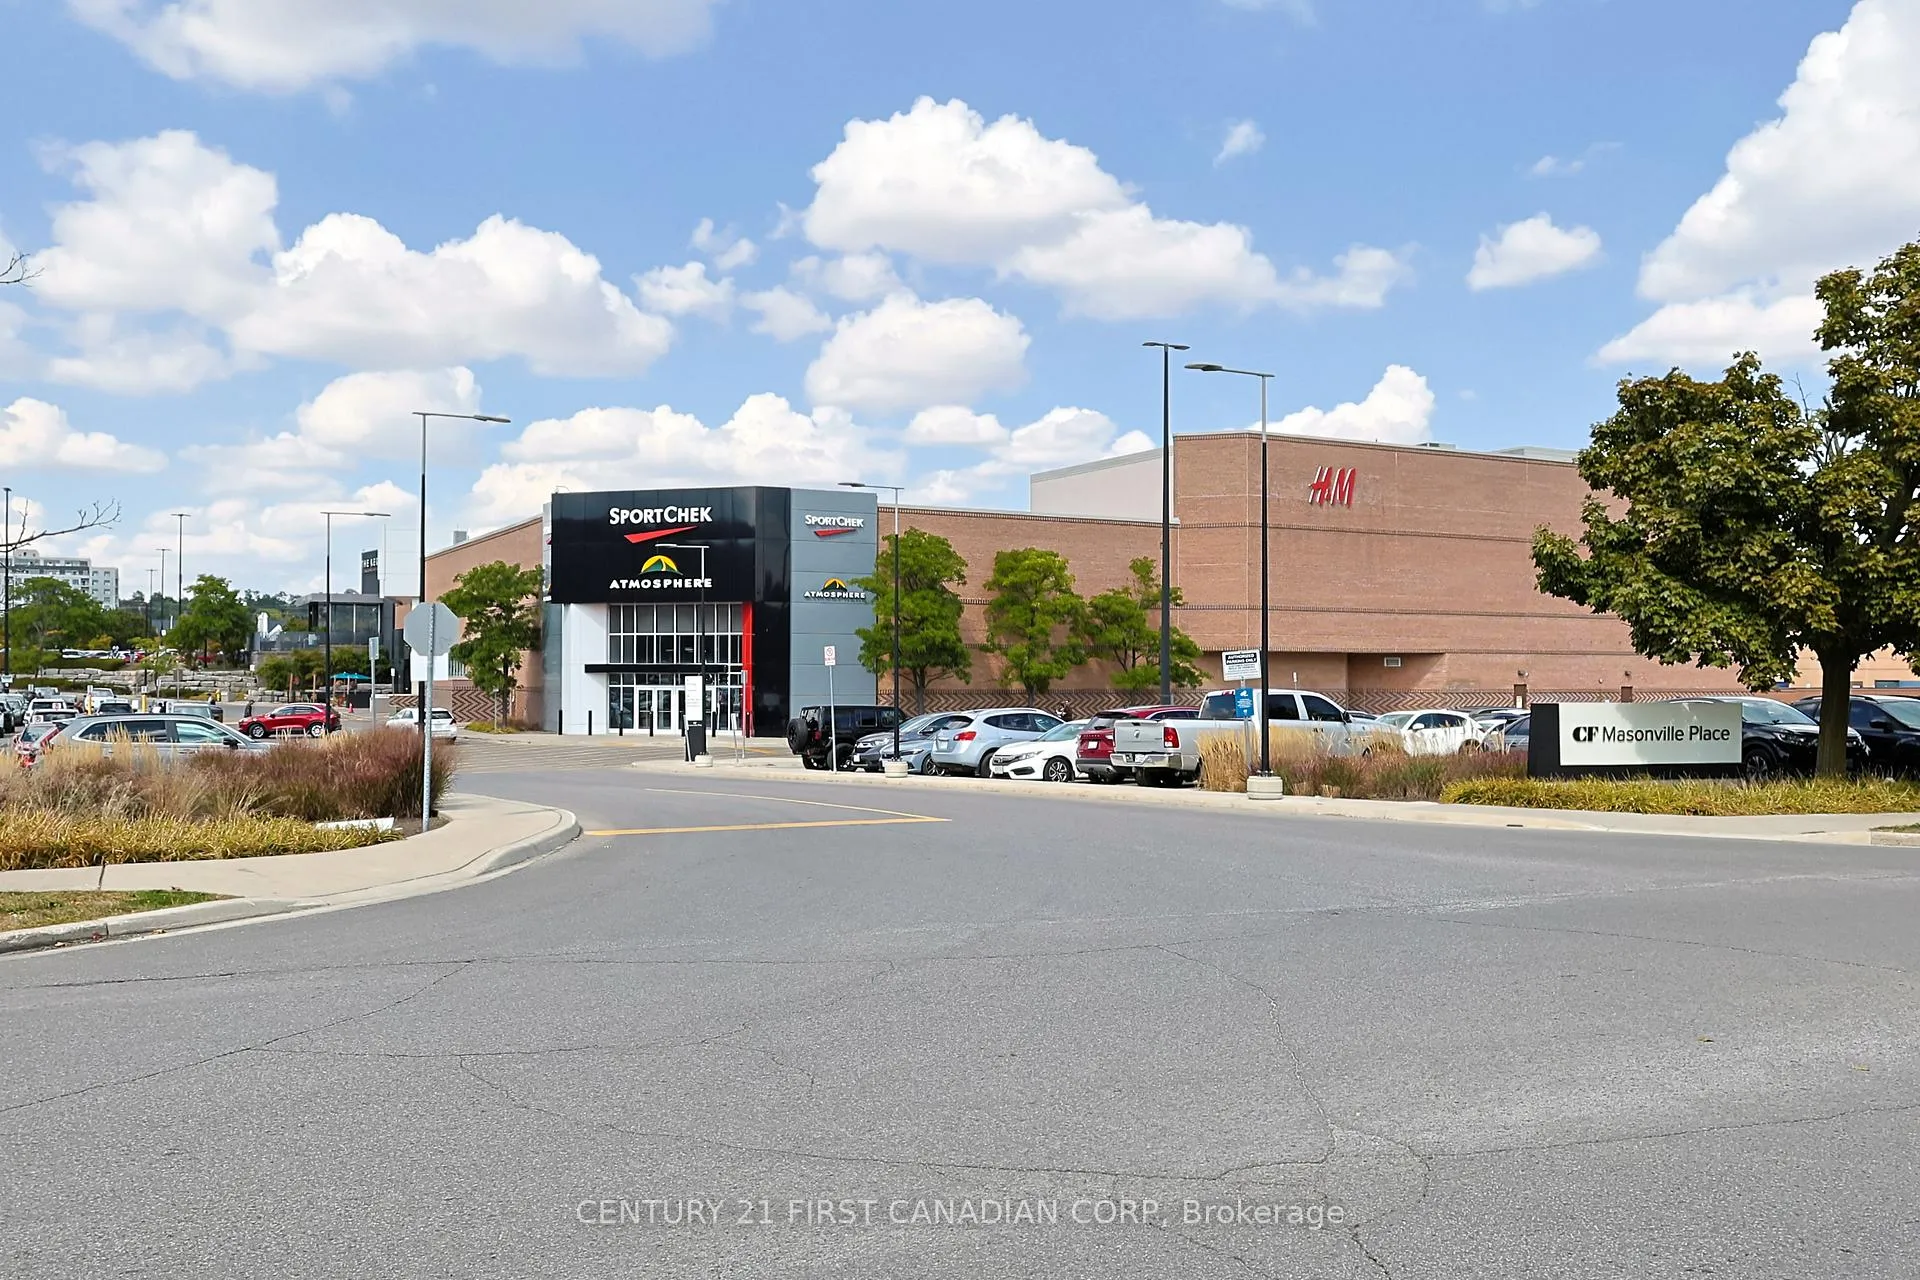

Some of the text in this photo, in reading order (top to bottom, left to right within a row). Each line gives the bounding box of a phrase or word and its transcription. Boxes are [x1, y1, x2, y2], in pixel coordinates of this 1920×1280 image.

[609, 578, 713, 589] ATMOSPHERE
[804, 591, 866, 599] ATMOSPHERE
[1572, 725, 1730, 742] CF Masonville Place
